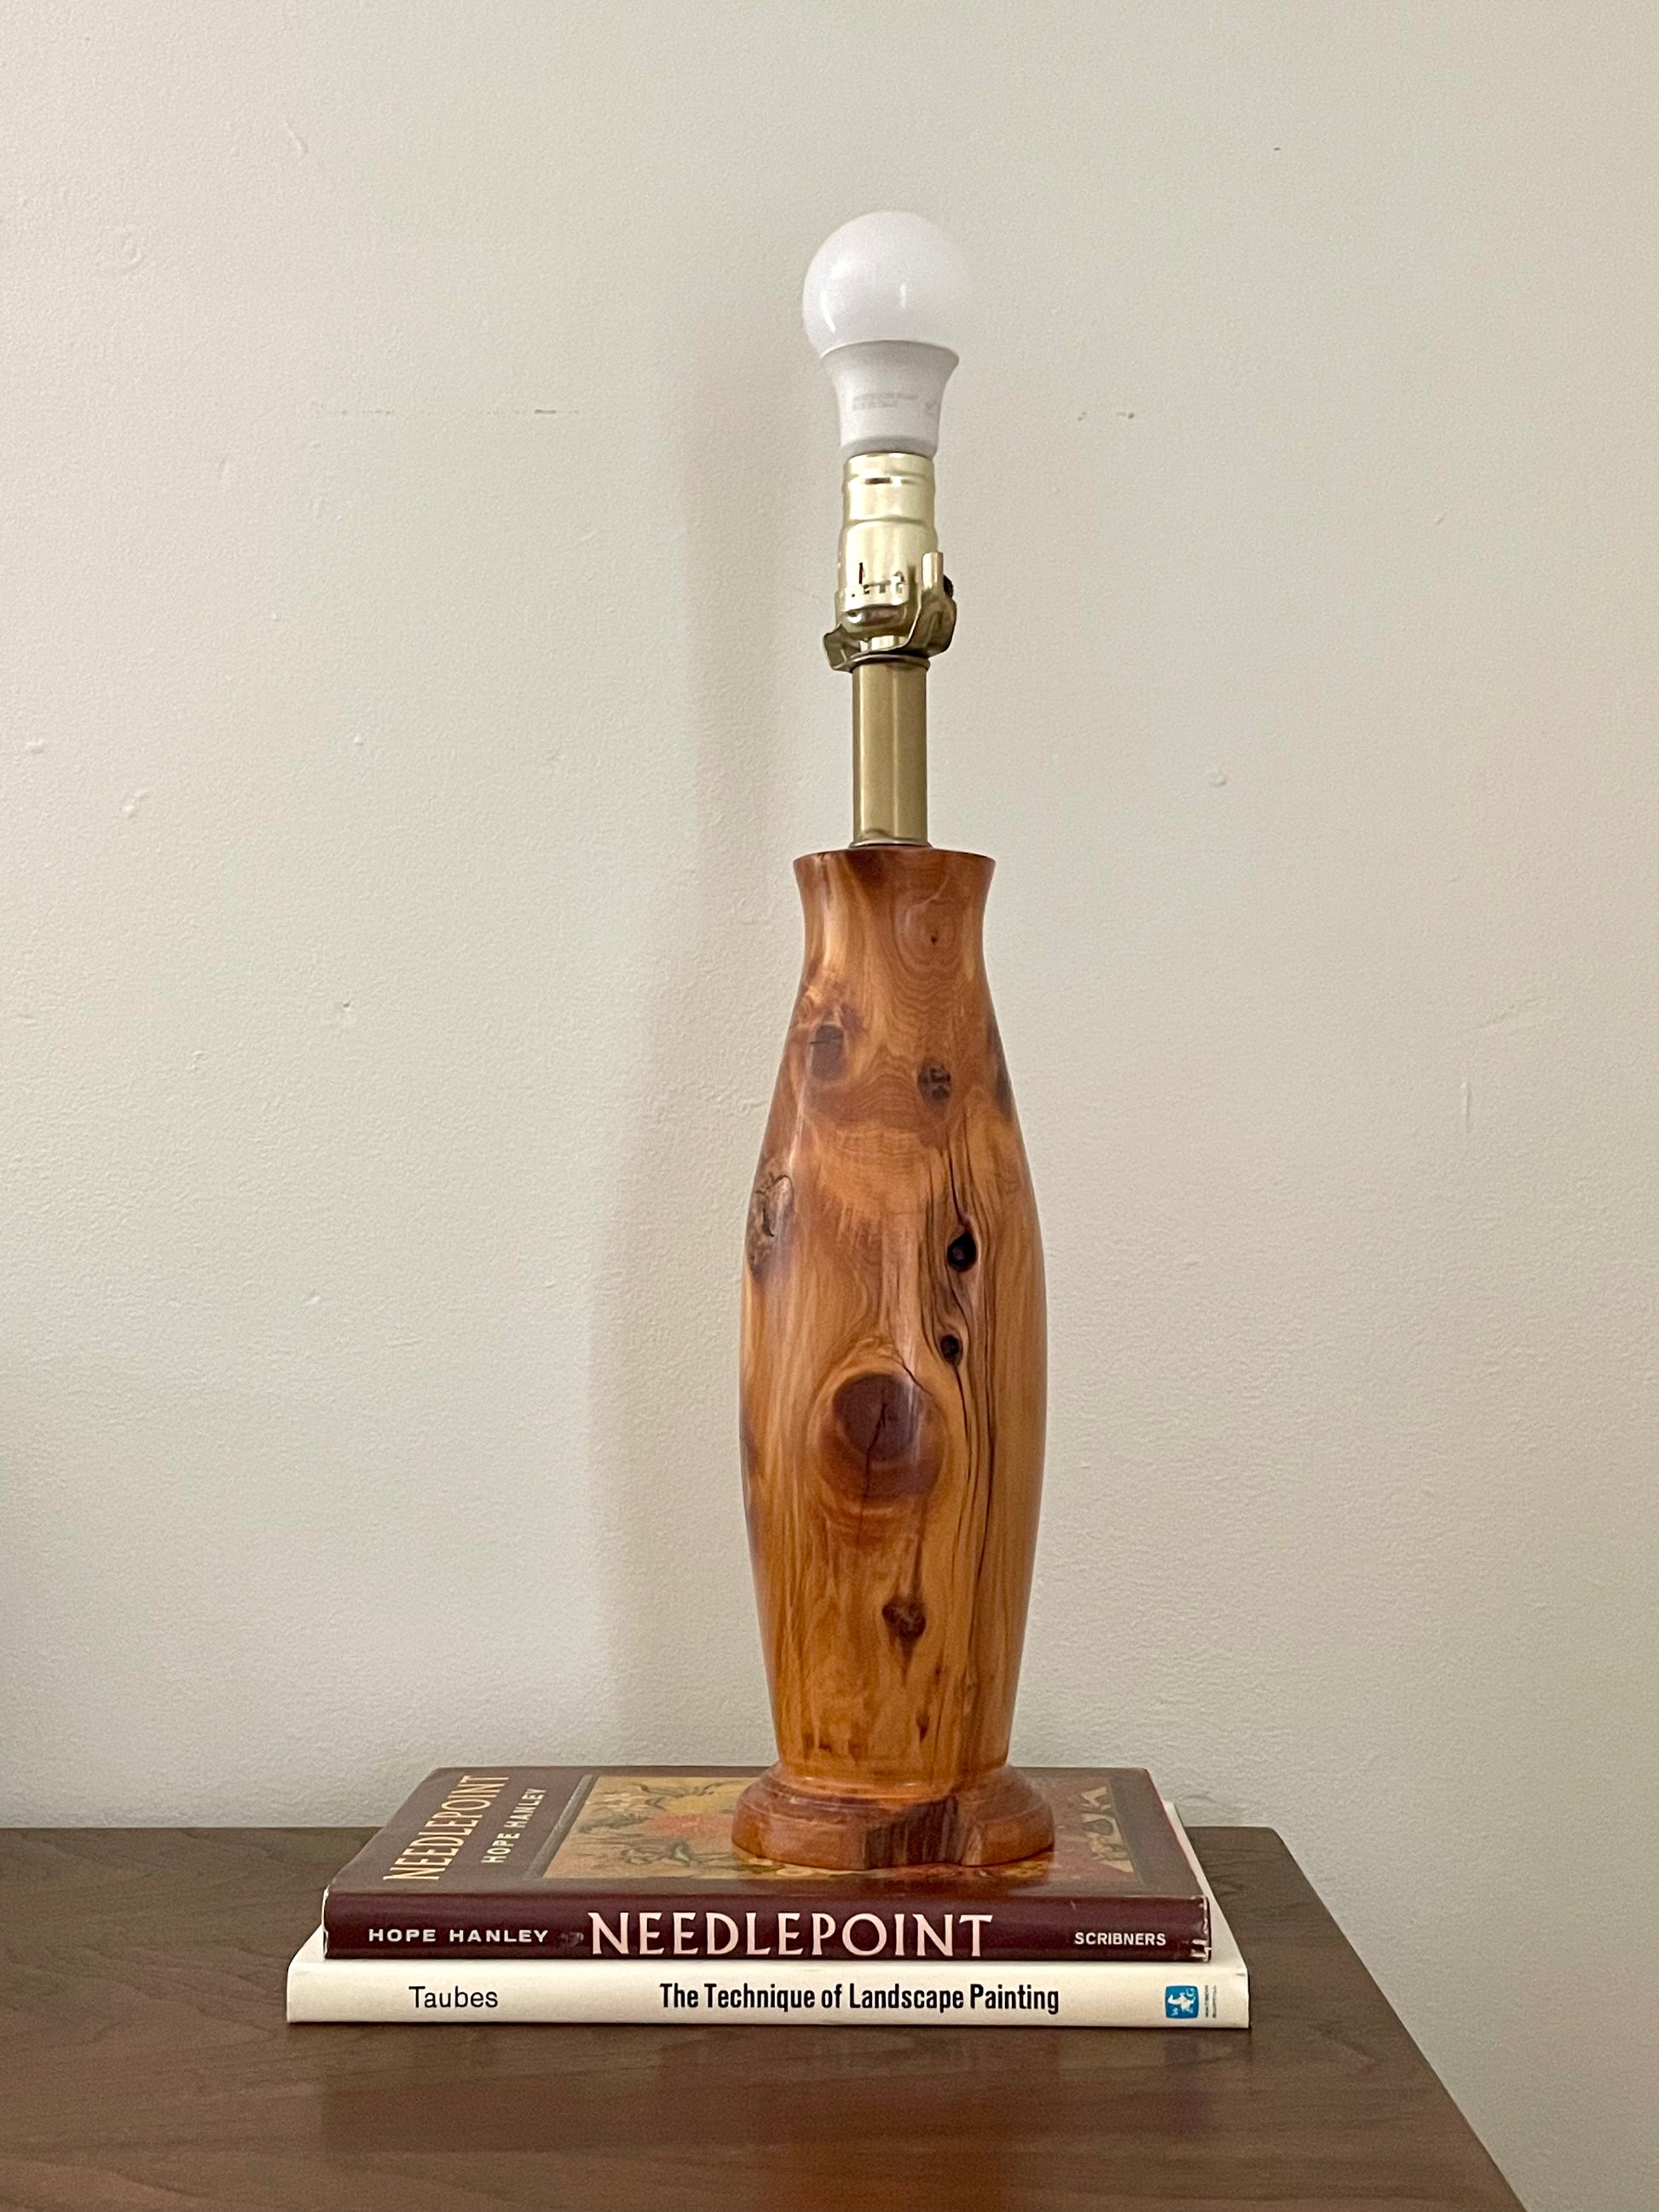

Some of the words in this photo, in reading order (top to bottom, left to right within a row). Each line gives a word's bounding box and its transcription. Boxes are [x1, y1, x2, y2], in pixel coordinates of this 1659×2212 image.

[382, 1774, 510, 1880] NEEDLEPOINT
[481, 1832, 521, 1863] HOPE
[506, 1788, 547, 1828] HANLEY
[367, 1928, 436, 1943] HOPE
[448, 1929, 548, 1943] HANLEY
[588, 1912, 993, 1956] NEEDLEPOINT
[1074, 1932, 1167, 1946] SCRIBNERS
[408, 1985, 499, 2008] Taubes
[660, 1983, 699, 2008] The
[704, 1983, 816, 2013] Technique
[821, 1984, 842, 2009] of
[849, 1984, 964, 2014] Landscape
[970, 1984, 1059, 2015] Painting
